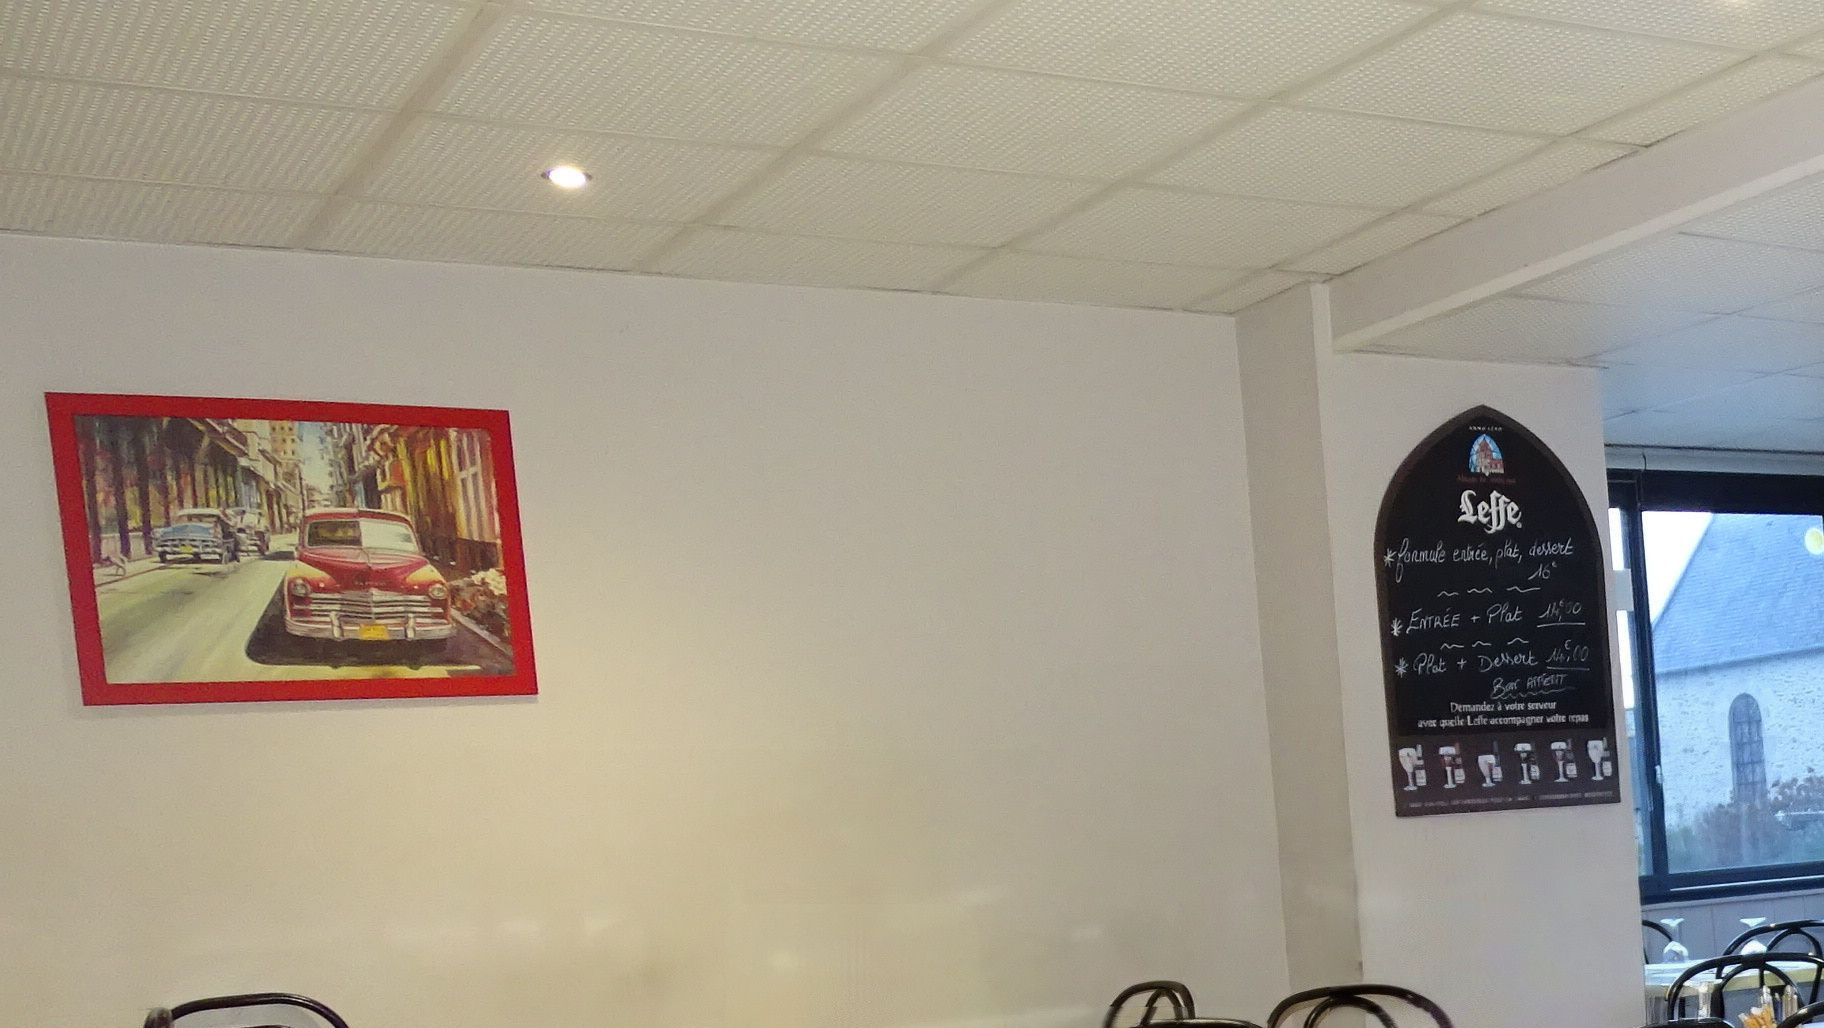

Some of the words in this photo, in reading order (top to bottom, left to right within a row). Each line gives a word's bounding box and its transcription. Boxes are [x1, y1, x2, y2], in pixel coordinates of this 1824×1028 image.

[1458, 490, 1522, 534] Leffe
[1529, 537, 1574, 557] dessert
[1470, 613, 1481, 623] +
[1486, 603, 1522, 624] Plat
[1413, 652, 1447, 675] Plat
[1457, 658, 1467, 670] +
[1477, 650, 1539, 673] Dessert
[1450, 701, 1495, 712] Demandez
[1497, 701, 1502, 711] à
[1504, 701, 1525, 711] votre
[1528, 701, 1557, 710] serveur
[1418, 718, 1437, 728] avec
[1439, 716, 1464, 729] quelle
[1467, 715, 1488, 726] Leffe
[1489, 715, 1543, 727] accompagner
[1546, 713, 1566, 723] votre
[1568, 714, 1589, 724] repas
